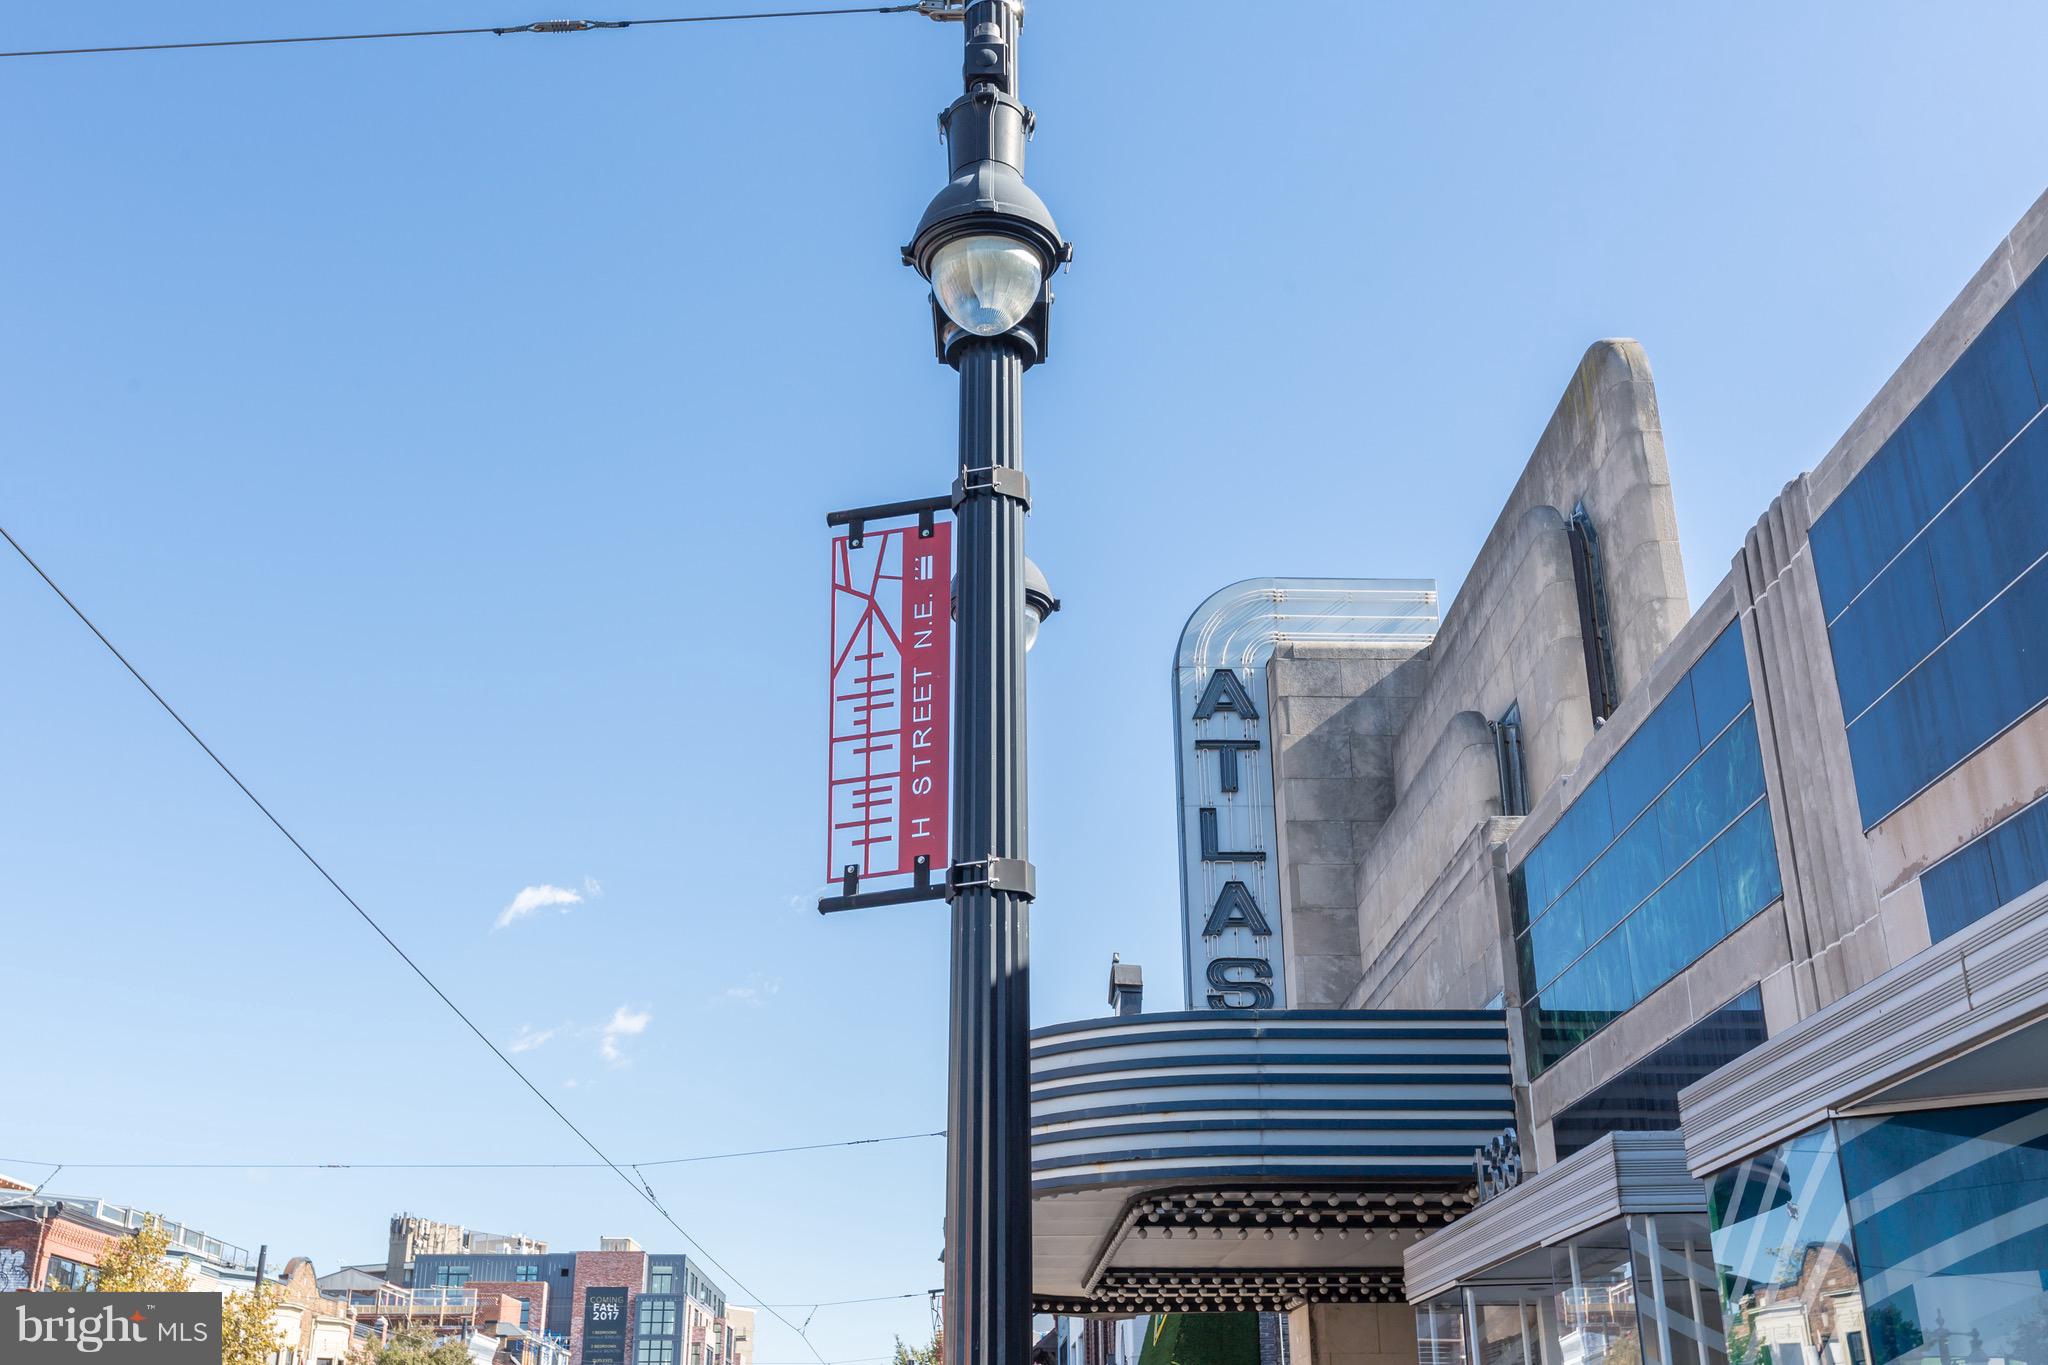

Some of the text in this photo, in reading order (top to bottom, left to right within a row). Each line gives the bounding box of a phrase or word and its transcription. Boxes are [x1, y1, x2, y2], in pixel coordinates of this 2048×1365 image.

[911, 593, 933, 838] H STREET N.E.
[1192, 668, 1274, 1010] ATLAS
[590, 1296, 624, 1304] COMING
[593, 1303, 619, 1311] FALL
[592, 1312, 619, 1320] 2017
